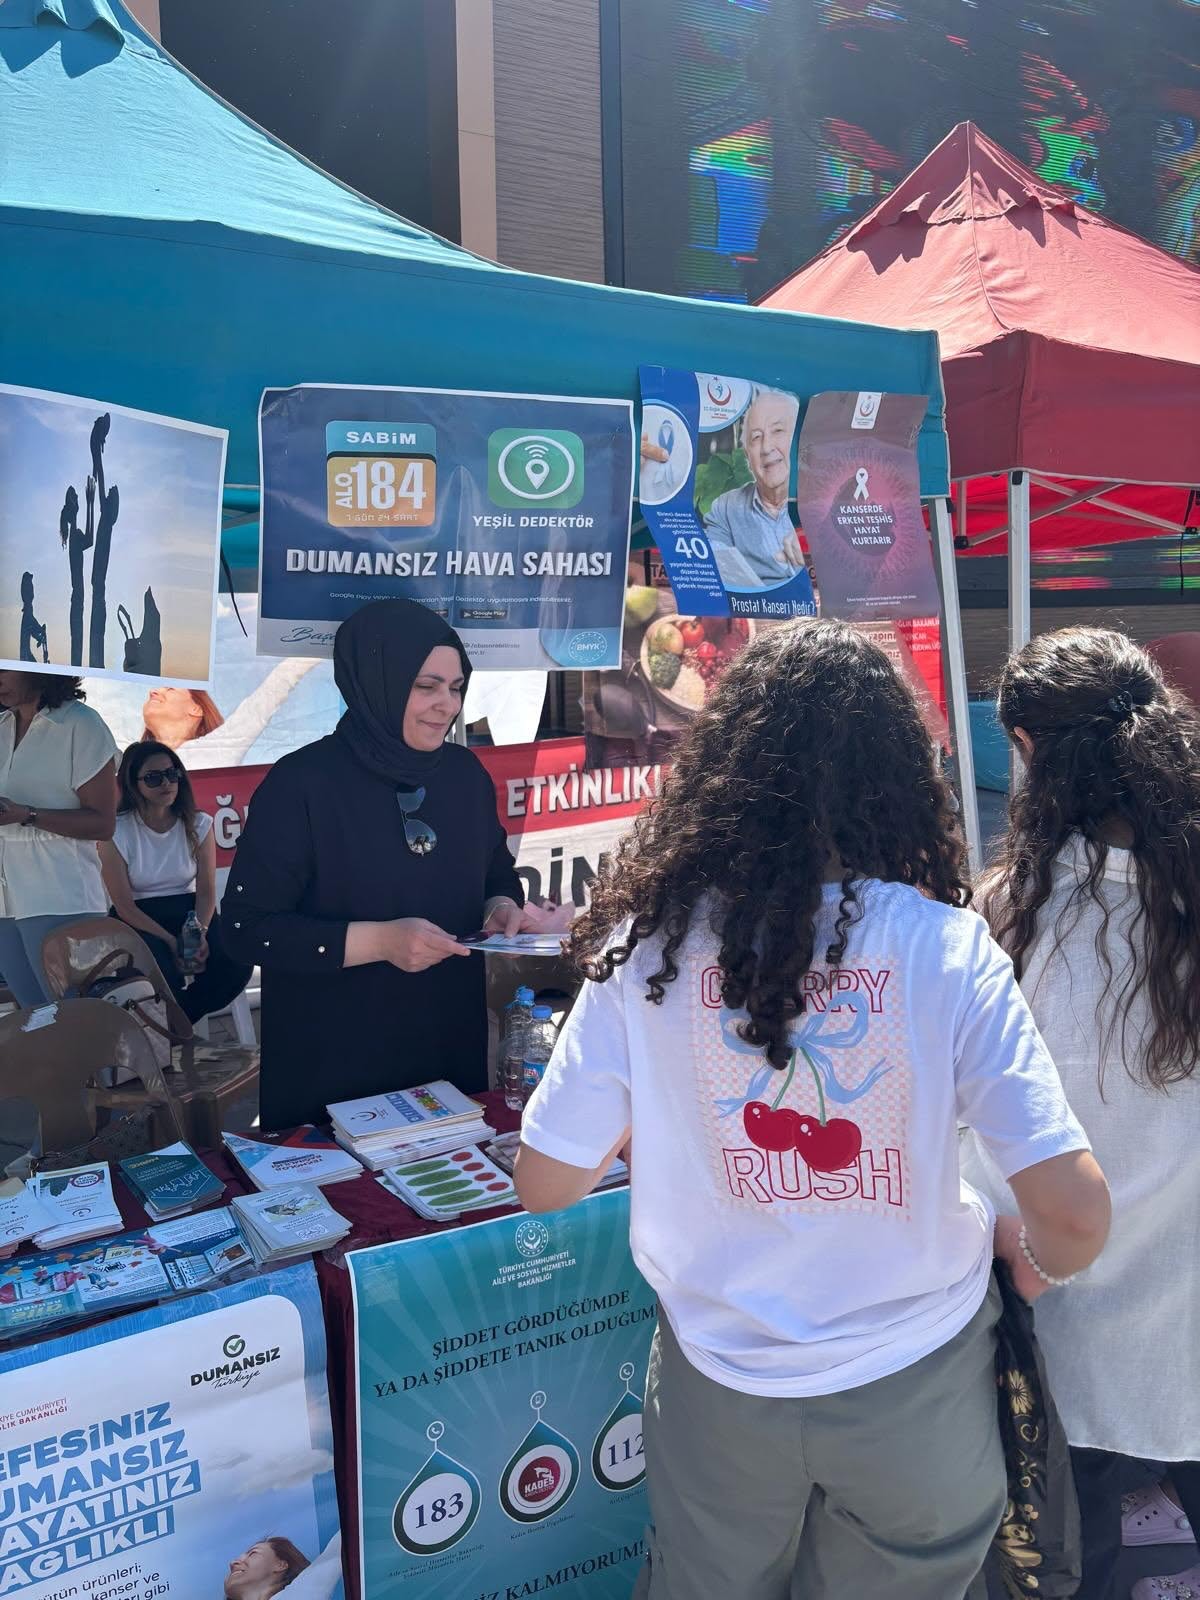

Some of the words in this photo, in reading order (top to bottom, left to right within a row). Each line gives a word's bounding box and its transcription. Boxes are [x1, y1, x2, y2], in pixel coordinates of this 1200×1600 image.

[335, 472, 352, 509] ALO
[350, 460, 427, 510] 184
[473, 514, 515, 529] YEŞİL
[519, 514, 594, 528] DEDEKTÖR
[837, 516, 864, 525] ERKEN
[840, 505, 883, 514] KANSERDE
[851, 536, 892, 545] KURTARIR
[854, 525, 881, 534] HAYAT
[675, 537, 709, 560] 40
[286, 548, 437, 577] DUMANSIZ
[446, 550, 515, 577] HAVA
[522, 551, 612, 577] SAHASI
[731, 597, 760, 613] Prostat
[762, 599, 791, 614] Kanseri
[702, 966, 890, 1013] CRRY
[722, 1148, 903, 1207] RUSH
[492, 1276, 507, 1286] AİLE
[507, 1274, 516, 1282] VE
[517, 1268, 541, 1280] SOSYAL
[541, 1258, 577, 1273] HİZMETLER
[499, 1262, 526, 1275] TÜRKİYE
[526, 1250, 569, 1267] CUMHURİYETİ
[517, 1273, 552, 1288] BAKANLIĞI
[432, 1325, 500, 1360] ŞİDDET
[504, 1289, 631, 1336] GÖRDÜĞÜMDE
[374, 1380, 399, 1398] YA
[402, 1371, 430, 1391] DA
[433, 1347, 513, 1386] ŞİDDETE
[514, 1330, 568, 1359] TANIK
[570, 1303, 658, 1341] OLDUĞUM
[190, 1346, 281, 1387] DUMANSIZ
[211, 1370, 261, 1389] Türkiye
[15, 1396, 67, 1418] CUMHURİYETİ
[19, 1405, 68, 1425] BAKANLIĞI
[608, 1432, 645, 1468] 112
[416, 1491, 464, 1529] 183
[0, 1508, 169, 1594] AĞLIKLI
[83, 1562, 142, 1591] ürünleri;
[144, 1570, 161, 1585] ve
[505, 1540, 644, 1600] KALMIYORUM!
[144, 1581, 171, 1599] gibi
